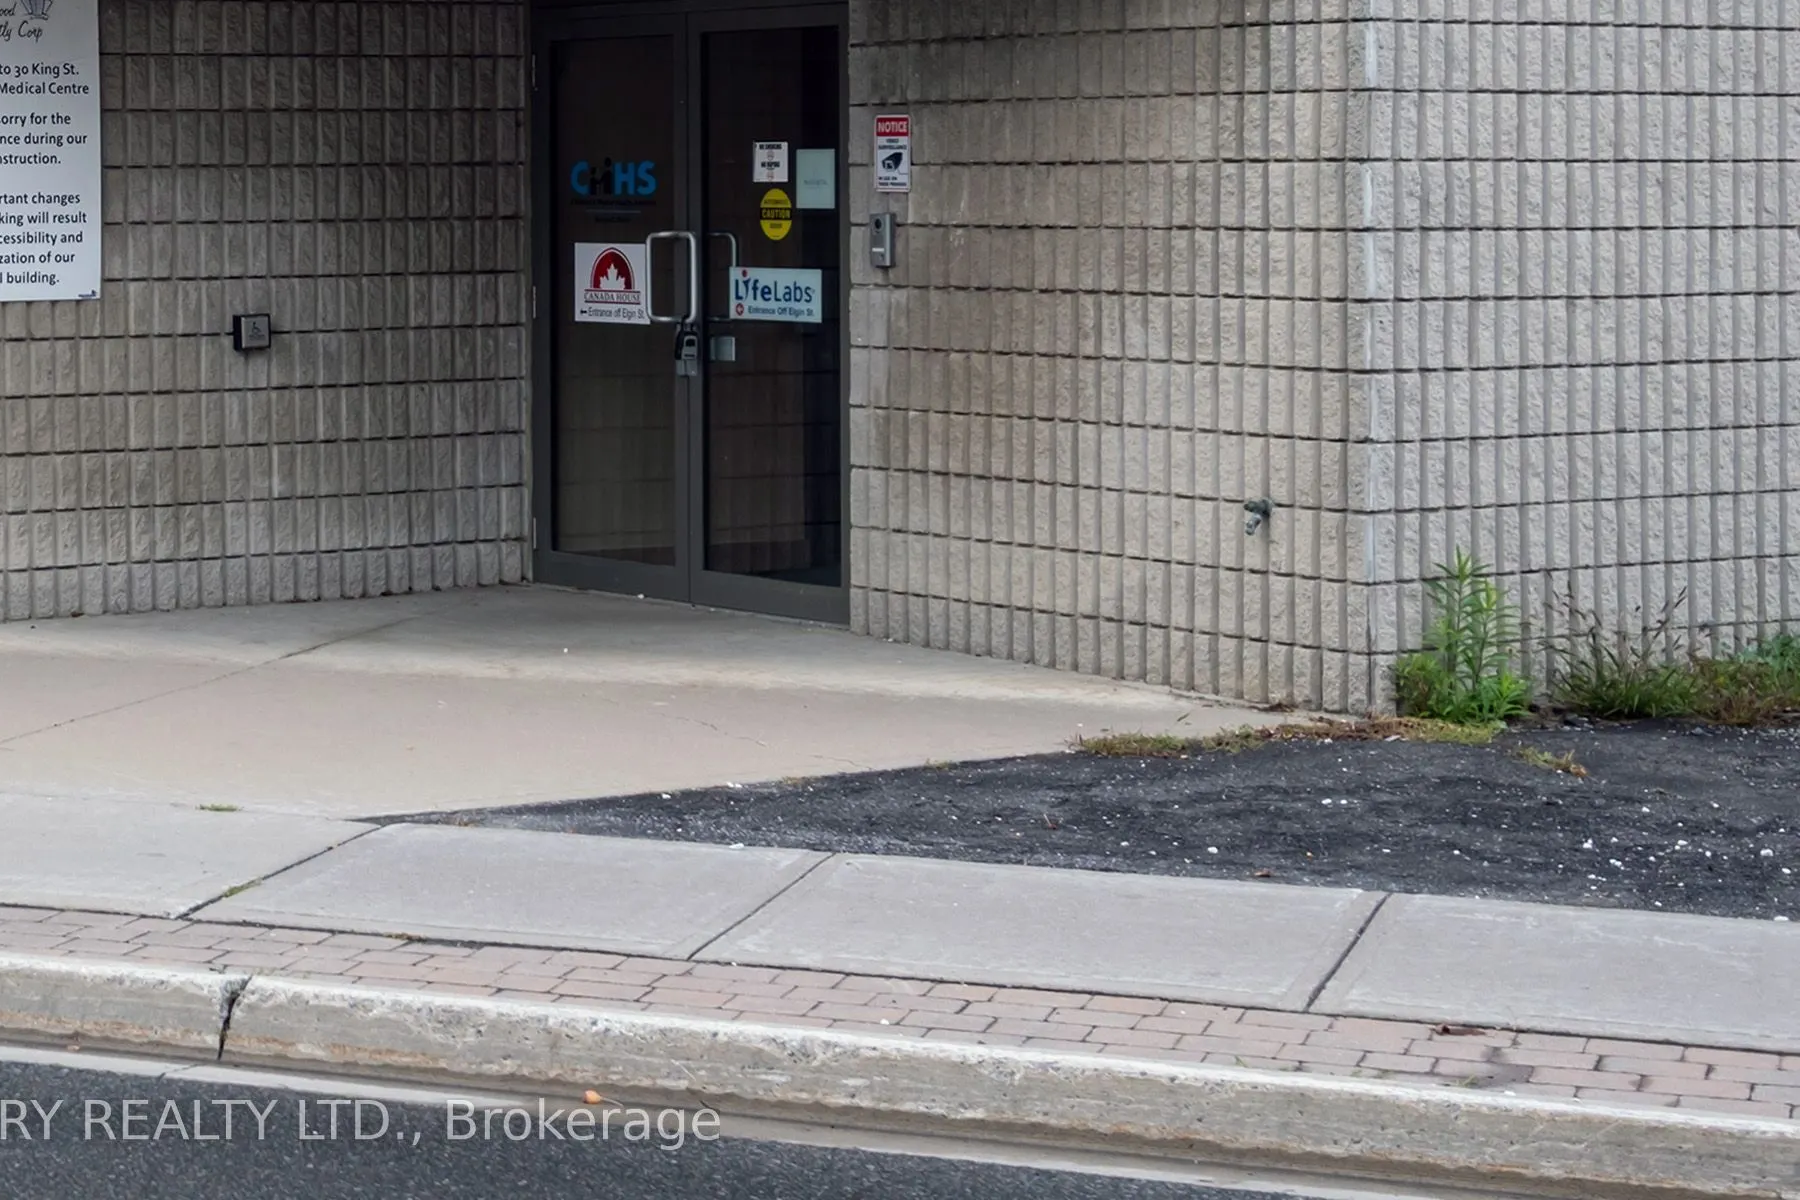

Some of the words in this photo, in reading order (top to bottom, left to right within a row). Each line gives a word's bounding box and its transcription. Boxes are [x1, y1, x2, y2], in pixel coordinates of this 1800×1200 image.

[18, 20, 43, 43] Corp
[14, 66, 29, 78] 30
[32, 62, 60, 78] King
[63, 63, 79, 75] St.
[48, 82, 89, 94] Centre
[30, 112, 48, 125] for
[51, 112, 71, 125] the
[878, 121, 908, 133] NOTICE
[24, 133, 64, 147] during
[66, 134, 87, 145] our
[31, 192, 81, 206] changes
[27, 212, 49, 224] will
[52, 211, 87, 224] result
[762, 208, 791, 219] CAUTION
[60, 231, 83, 243] and
[39, 251, 52, 263] of
[54, 253, 75, 263] our
[6, 271, 60, 285] building.
[734, 269, 812, 303] LifeLabs
[584, 292, 614, 301] CANADA
[617, 292, 641, 301] HOUSE
[588, 307, 612, 317] Entrance
[748, 306, 775, 315] Entrance
